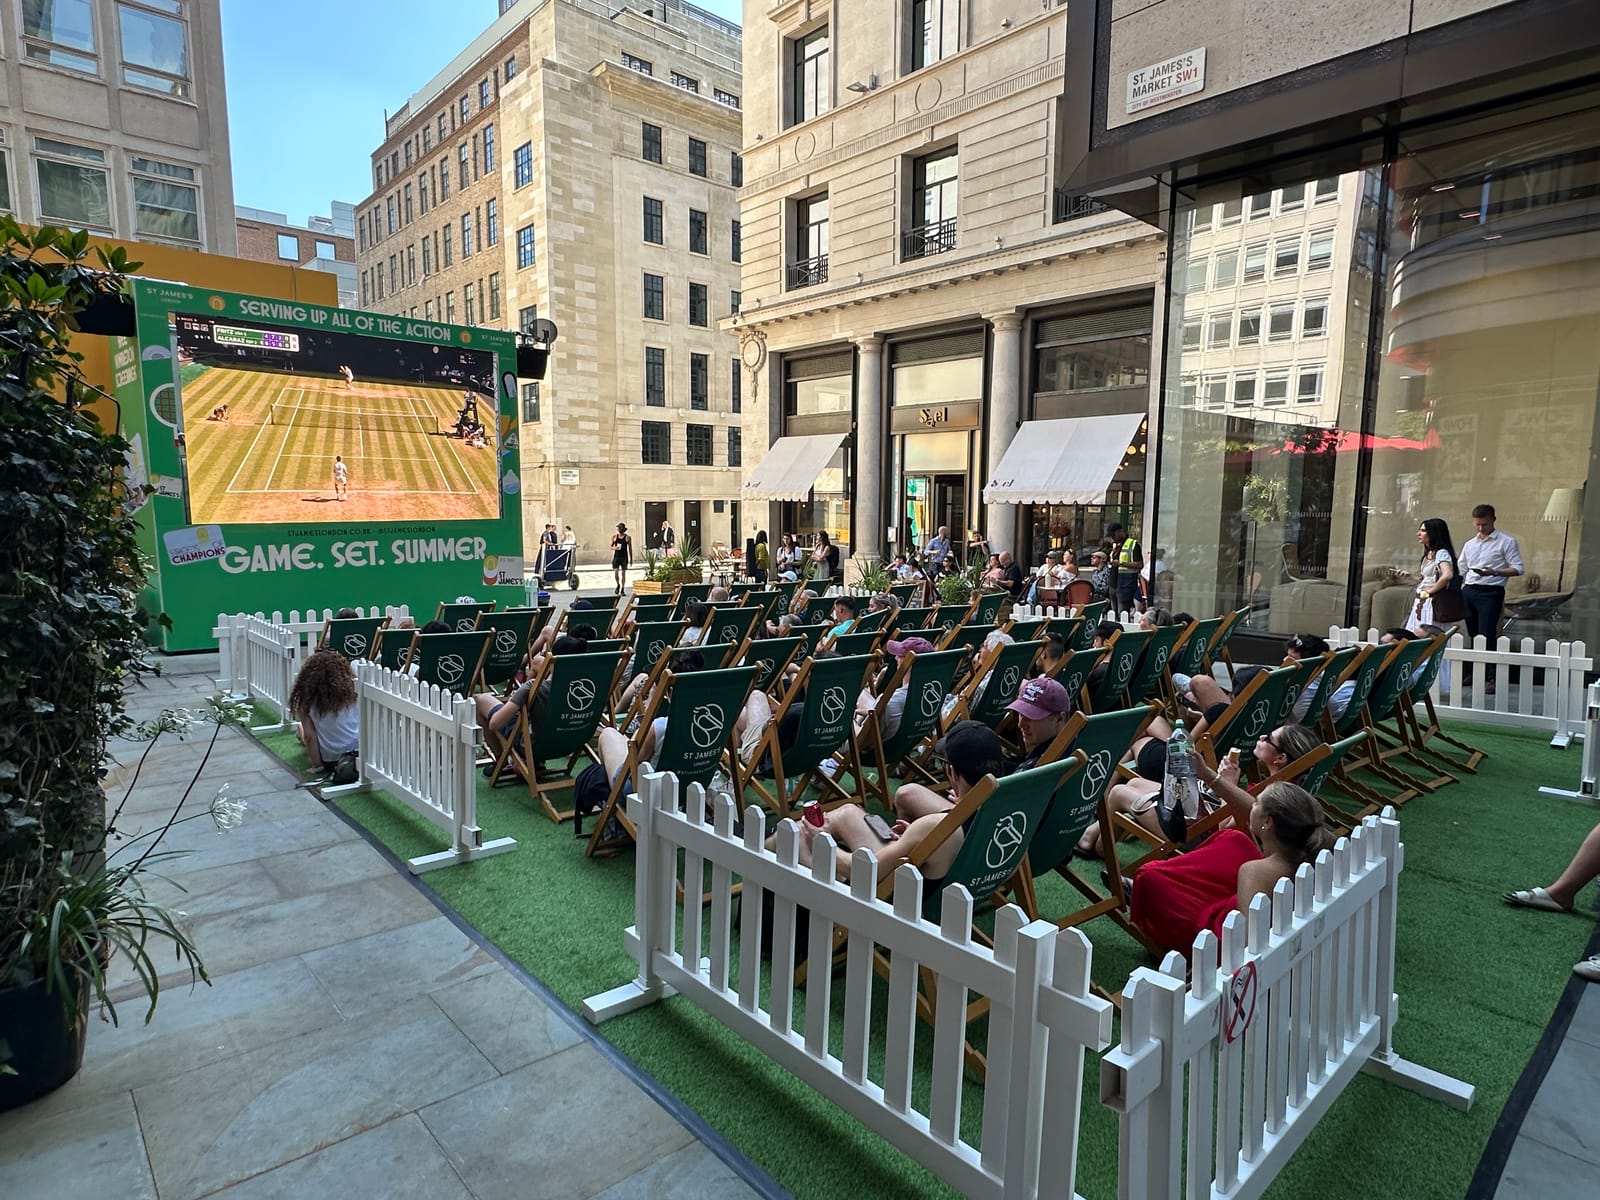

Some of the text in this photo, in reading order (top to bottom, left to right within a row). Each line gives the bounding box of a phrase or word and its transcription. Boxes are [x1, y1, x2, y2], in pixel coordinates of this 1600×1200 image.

[1133, 55, 1193, 86] ST. JAMES'S
[1132, 67, 1198, 99] MARKET SW1
[1131, 102, 1143, 110] CITY
[1149, 89, 1182, 104] WESTMINSTER
[146, 287, 158, 295] ST
[239, 299, 451, 341] SERVING UP ALL OF THE ACTION
[216, 327, 234, 335] FRITZ
[217, 335, 245, 344] ALCARAZ
[172, 546, 226, 564] CHAMPIONS
[219, 543, 325, 574] GAME.
[330, 540, 385, 568] SET.
[391, 536, 487, 565] SUMMER
[683, 752, 693, 760] ST
[1069, 807, 1079, 816] ST
[969, 877, 982, 887] ST
